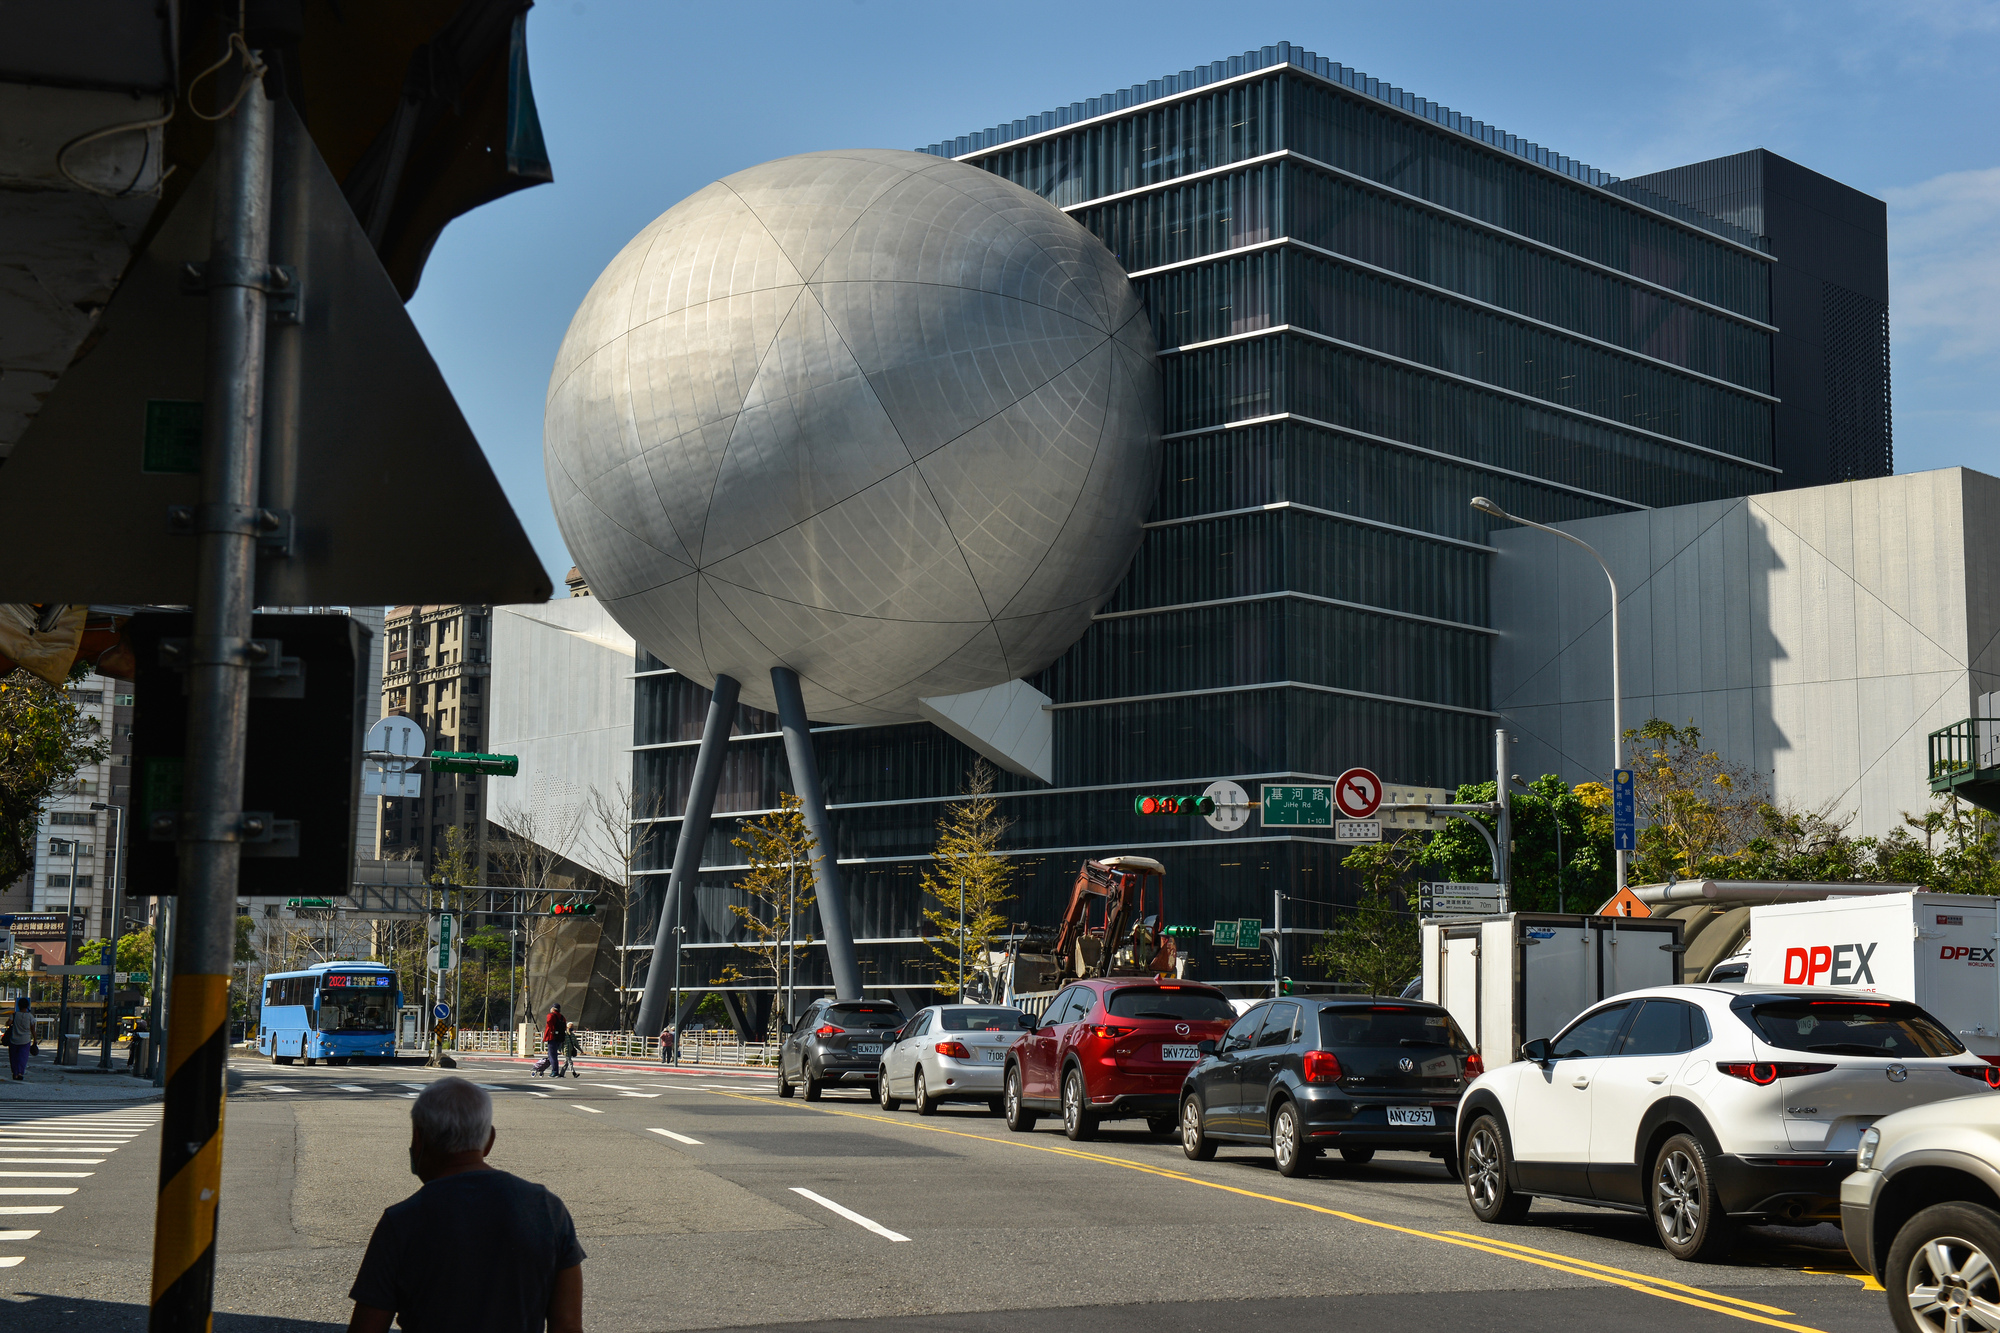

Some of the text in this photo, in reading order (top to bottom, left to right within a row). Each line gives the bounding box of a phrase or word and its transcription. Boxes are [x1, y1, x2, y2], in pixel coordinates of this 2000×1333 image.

[1271, 788, 1324, 800] 基河路
[1940, 946, 1996, 962] DPEX
[1783, 942, 1878, 986] DPEX
[329, 975, 346, 987] 2022
[1163, 1048, 1199, 1058] BKV-7220
[1389, 1110, 1433, 1122] ANY-2937
